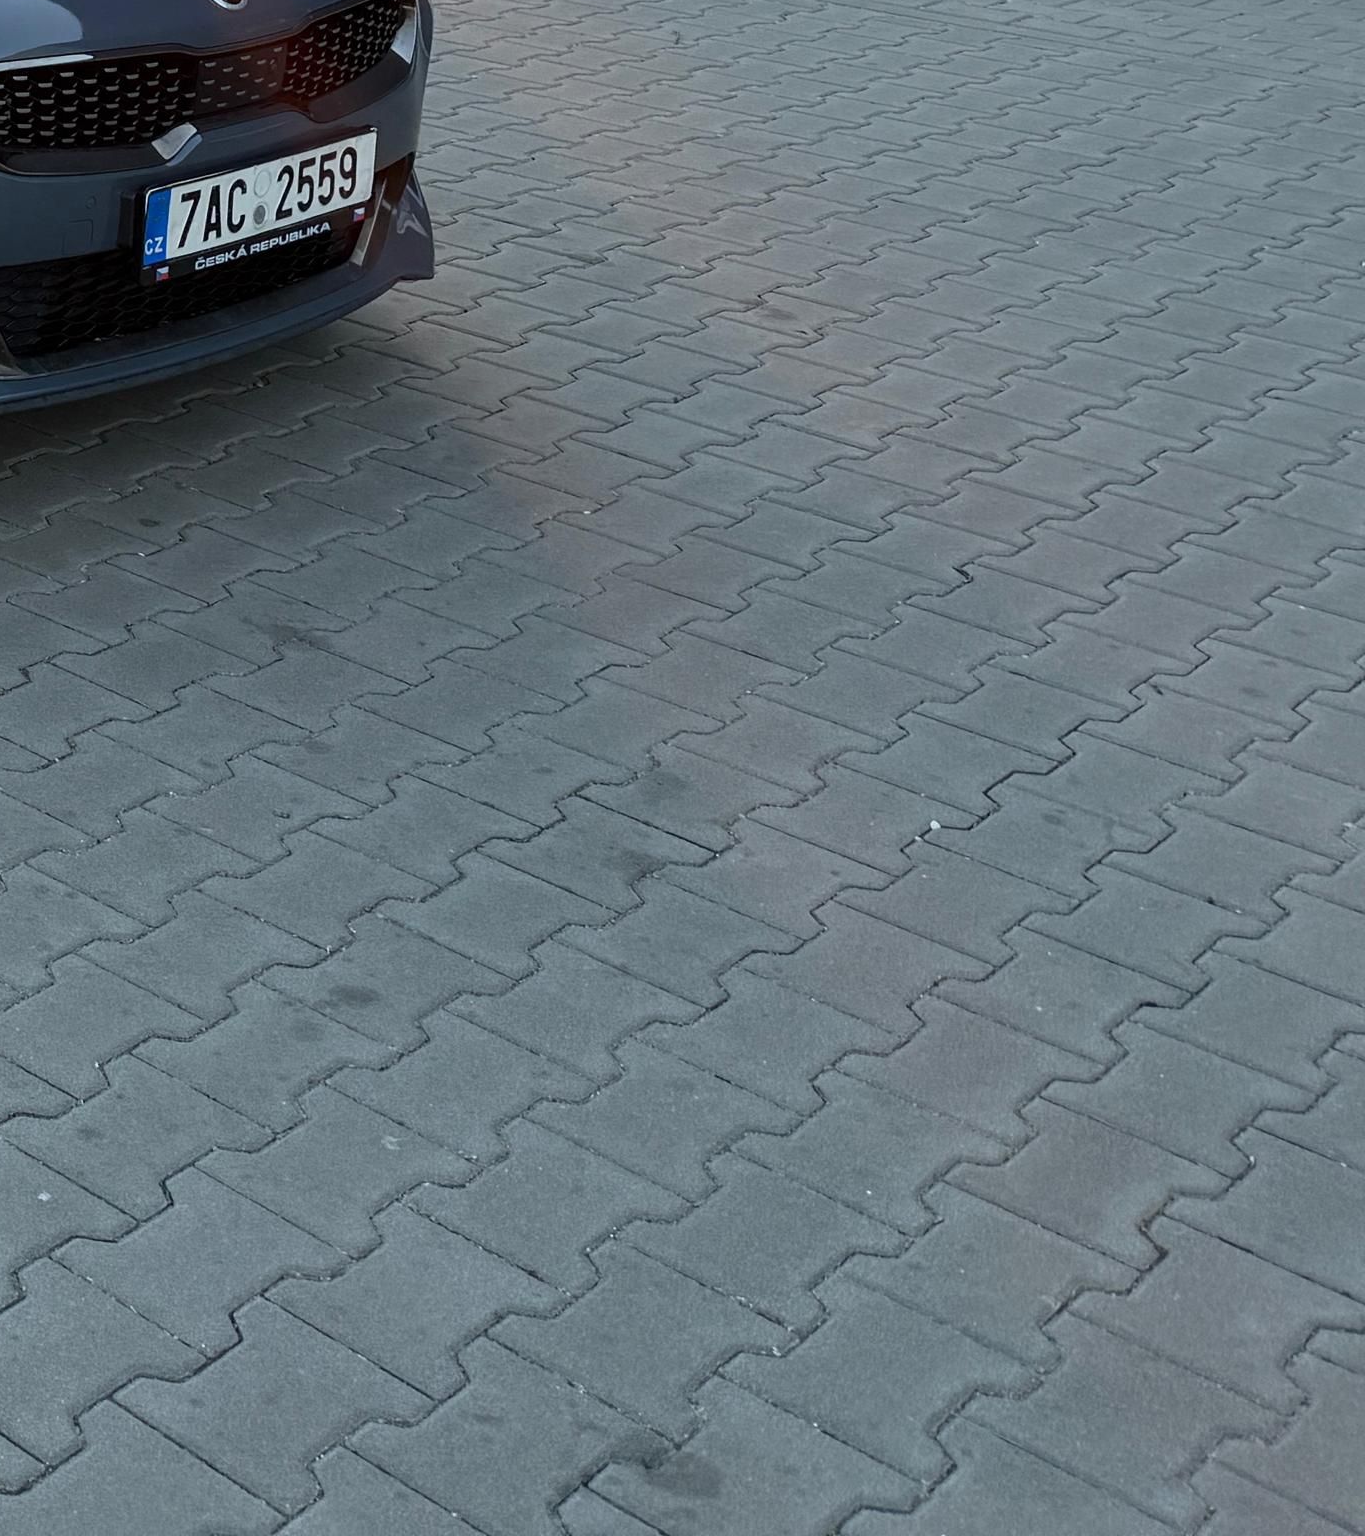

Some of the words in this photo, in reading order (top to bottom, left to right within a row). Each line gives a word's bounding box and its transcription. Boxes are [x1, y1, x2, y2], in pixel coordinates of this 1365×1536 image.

[178, 179, 247, 248] 7AC
[275, 147, 357, 221] 2559
[144, 236, 164, 255] CZ
[195, 245, 247, 270] ČESKÁ
[249, 221, 331, 255] REPUBLIKA
